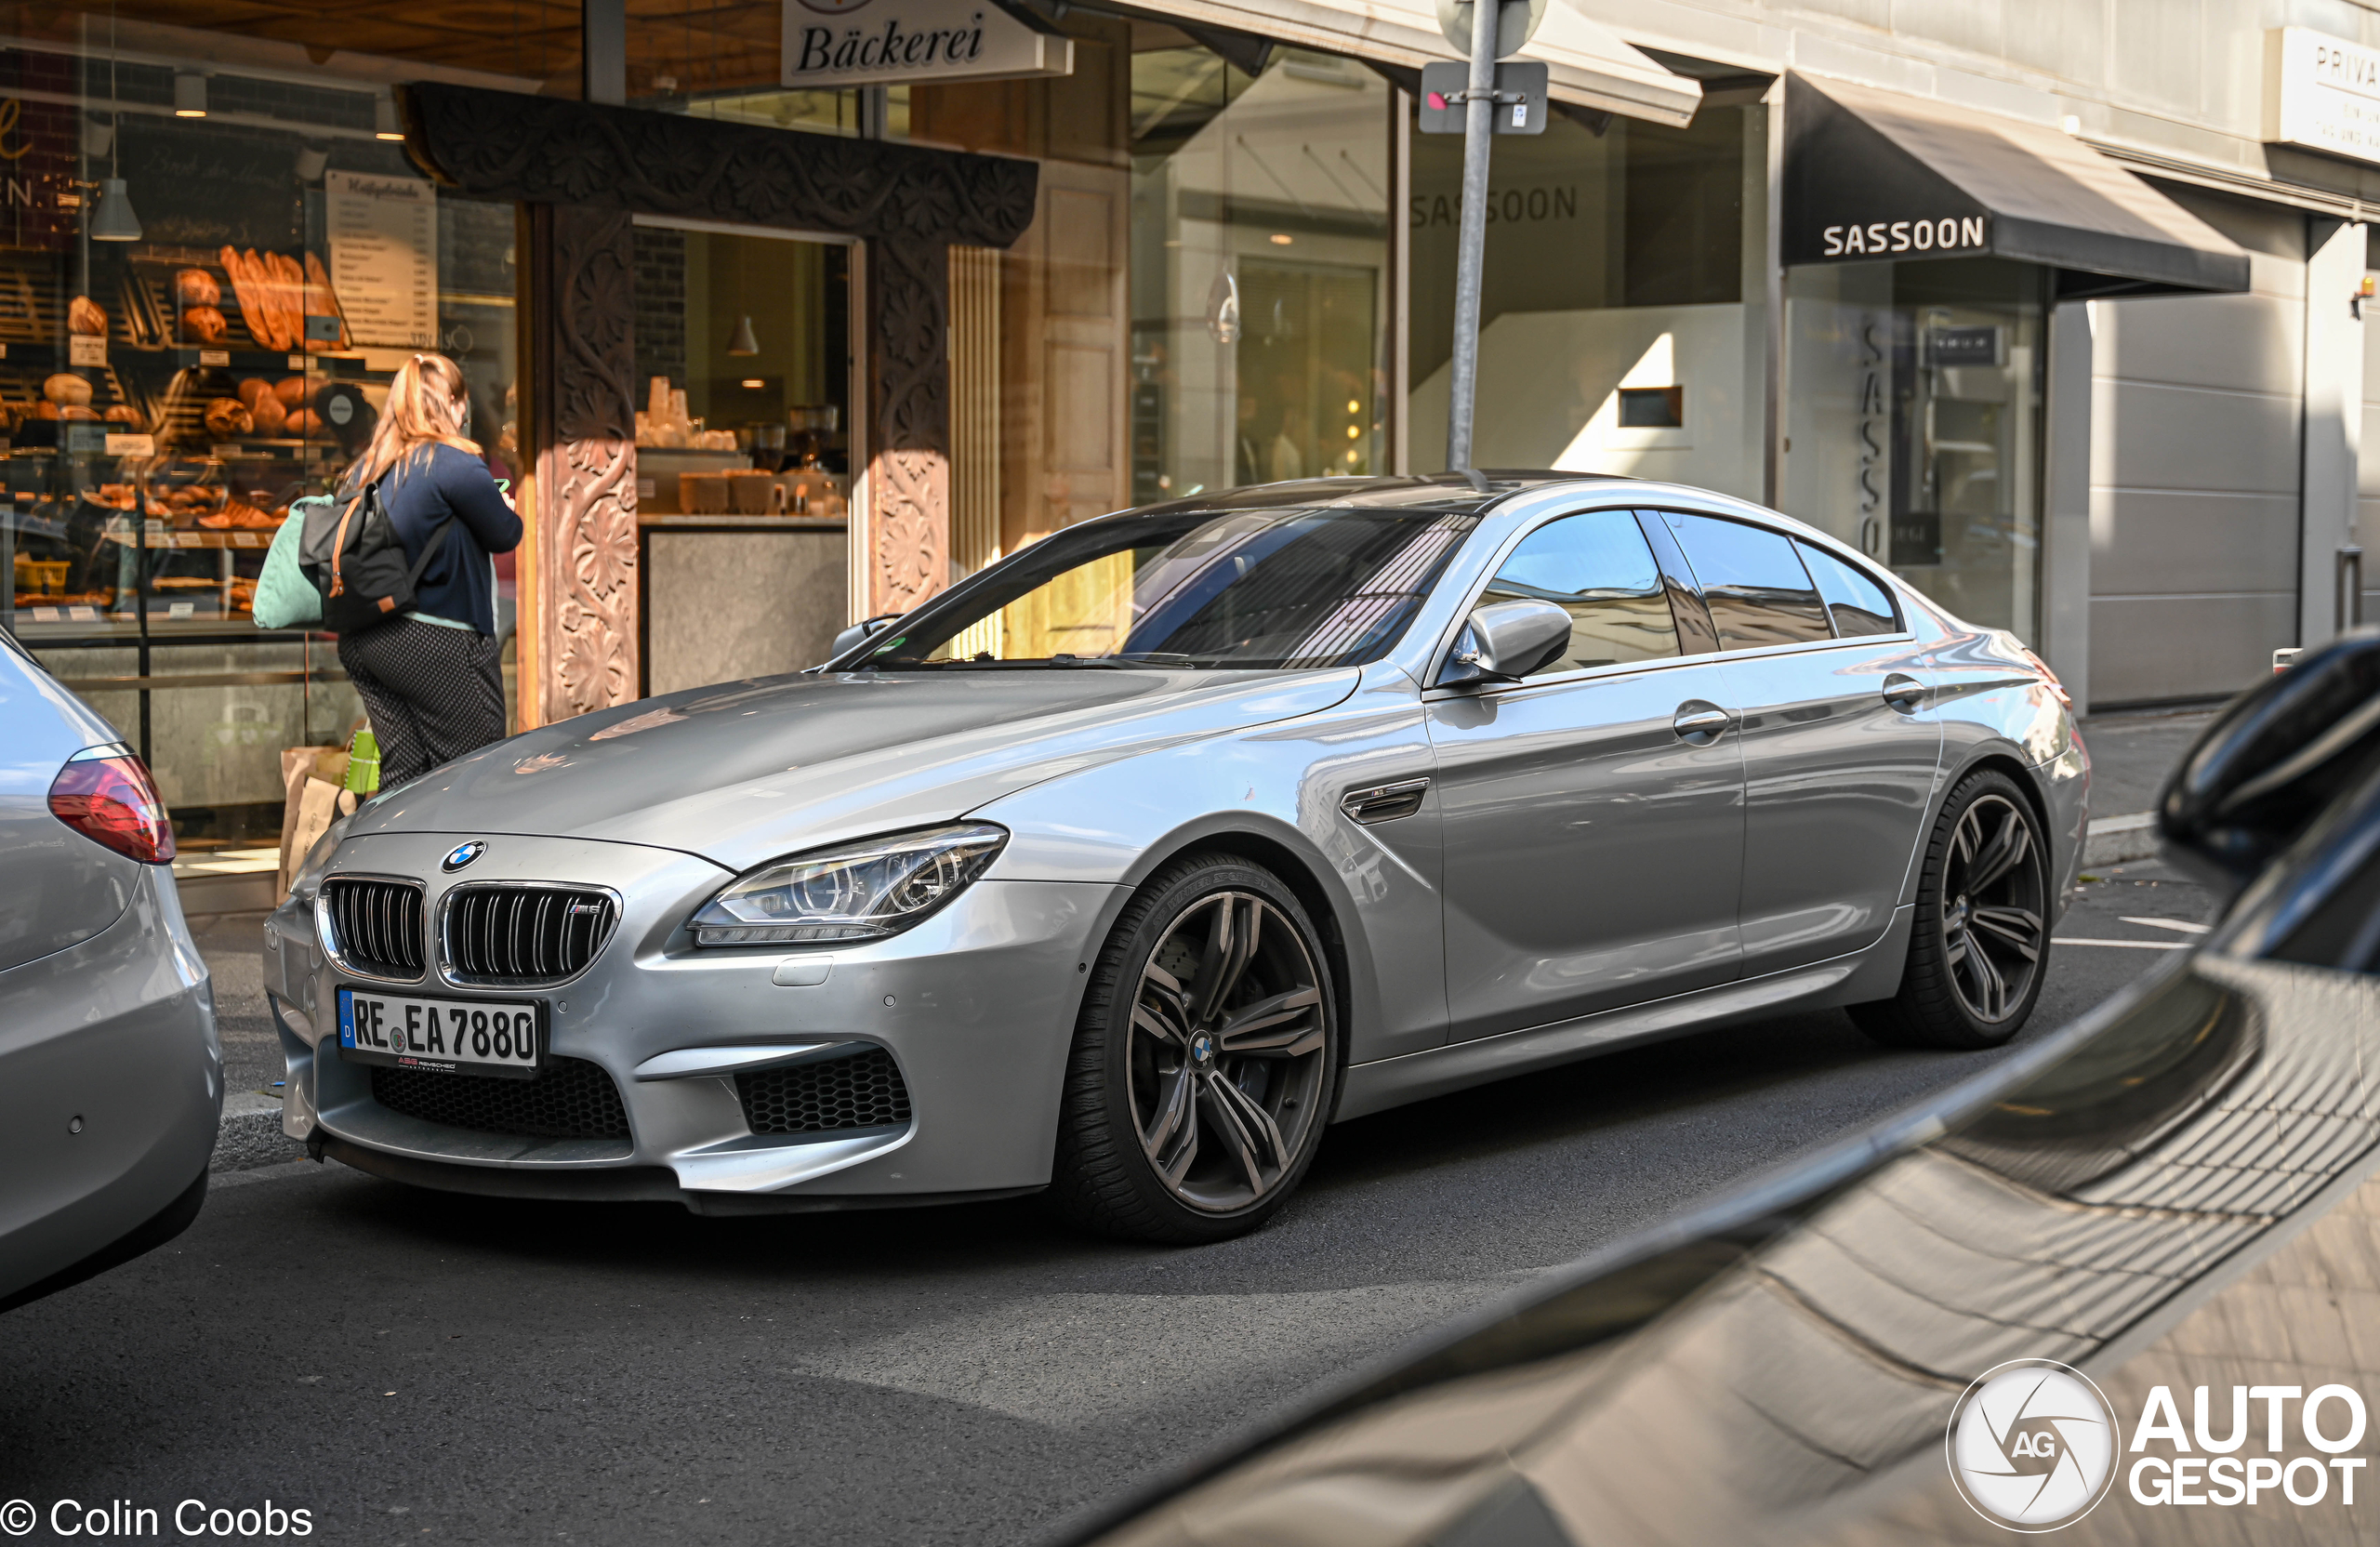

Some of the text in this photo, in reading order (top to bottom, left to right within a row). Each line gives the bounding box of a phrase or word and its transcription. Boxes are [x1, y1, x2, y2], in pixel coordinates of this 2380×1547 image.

[797, 11, 985, 73] Bäckerei
[1823, 216, 1984, 257] SASSOON
[1167, 876, 1211, 910] WINTER
[1253, 878, 1268, 889] 3D
[344, 1025, 351, 1038] D
[353, 998, 389, 1048] RE
